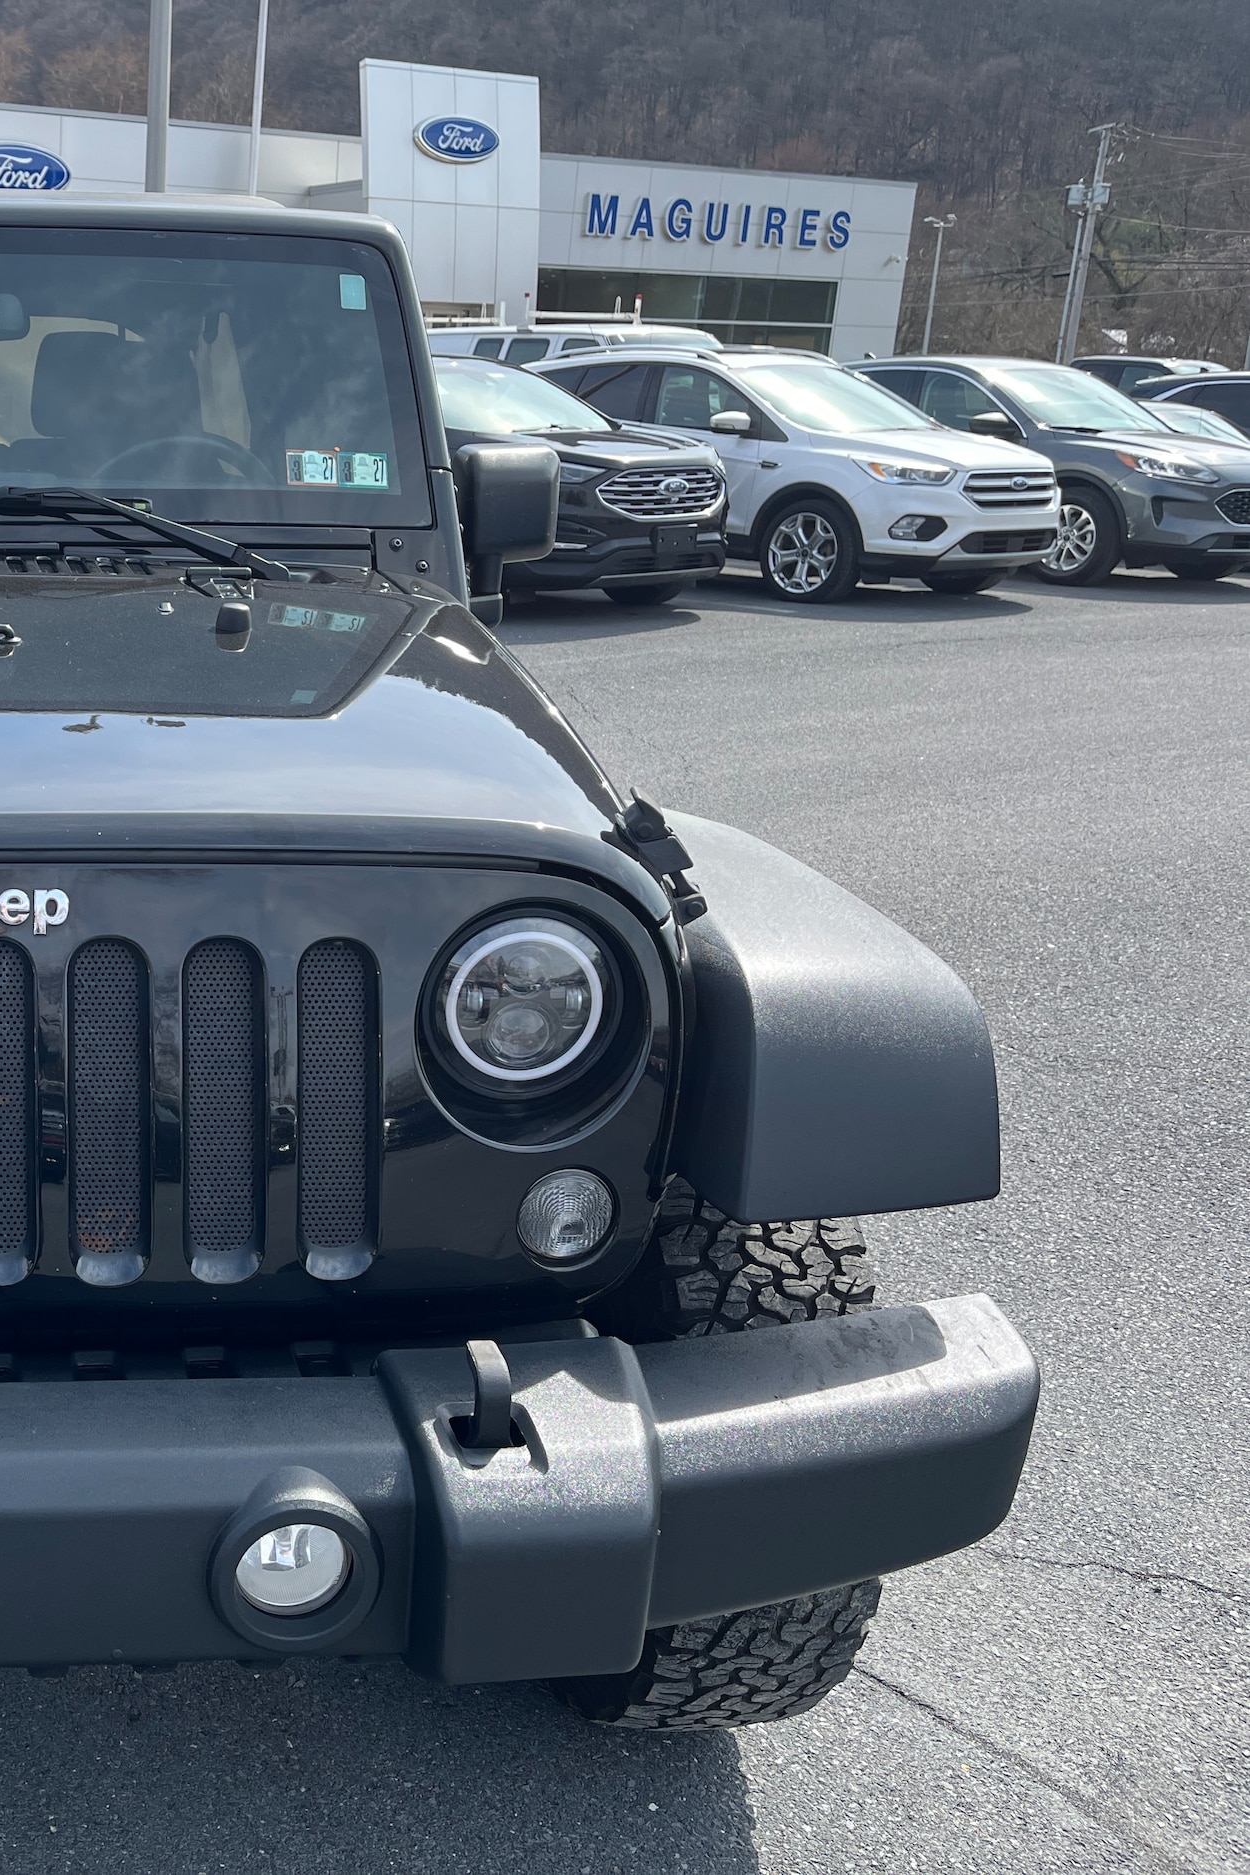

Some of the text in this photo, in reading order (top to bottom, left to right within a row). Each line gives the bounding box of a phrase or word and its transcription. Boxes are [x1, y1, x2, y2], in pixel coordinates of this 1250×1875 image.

[438, 123, 484, 152] Ford
[587, 193, 851, 250] MAGUIRES
[322, 456, 334, 481] 27
[373, 458, 384, 484] 27
